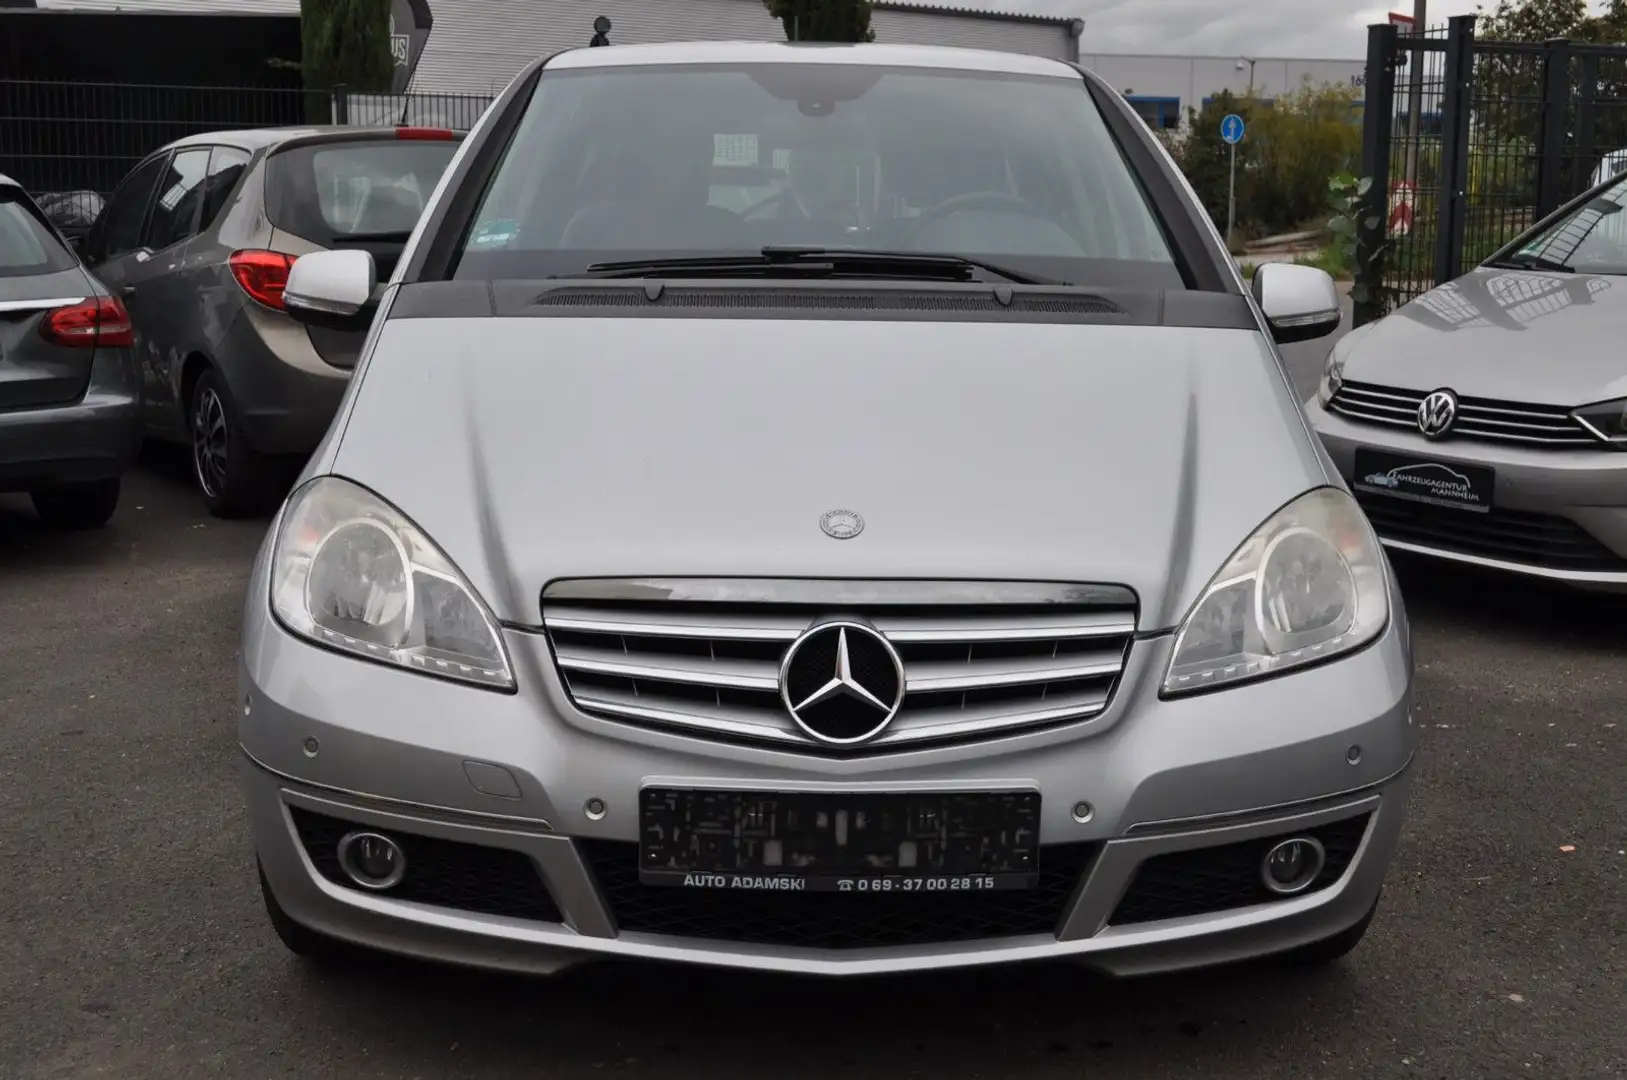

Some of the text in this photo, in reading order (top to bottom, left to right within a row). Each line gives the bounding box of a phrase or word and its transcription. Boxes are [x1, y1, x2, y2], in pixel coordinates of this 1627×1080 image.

[1392, 471, 1468, 492] FAHRZEUGAGENTUR
[1431, 487, 1480, 502] MANNHEIM
[684, 874, 726, 888] AUTO
[731, 876, 806, 891] ADAMSKI
